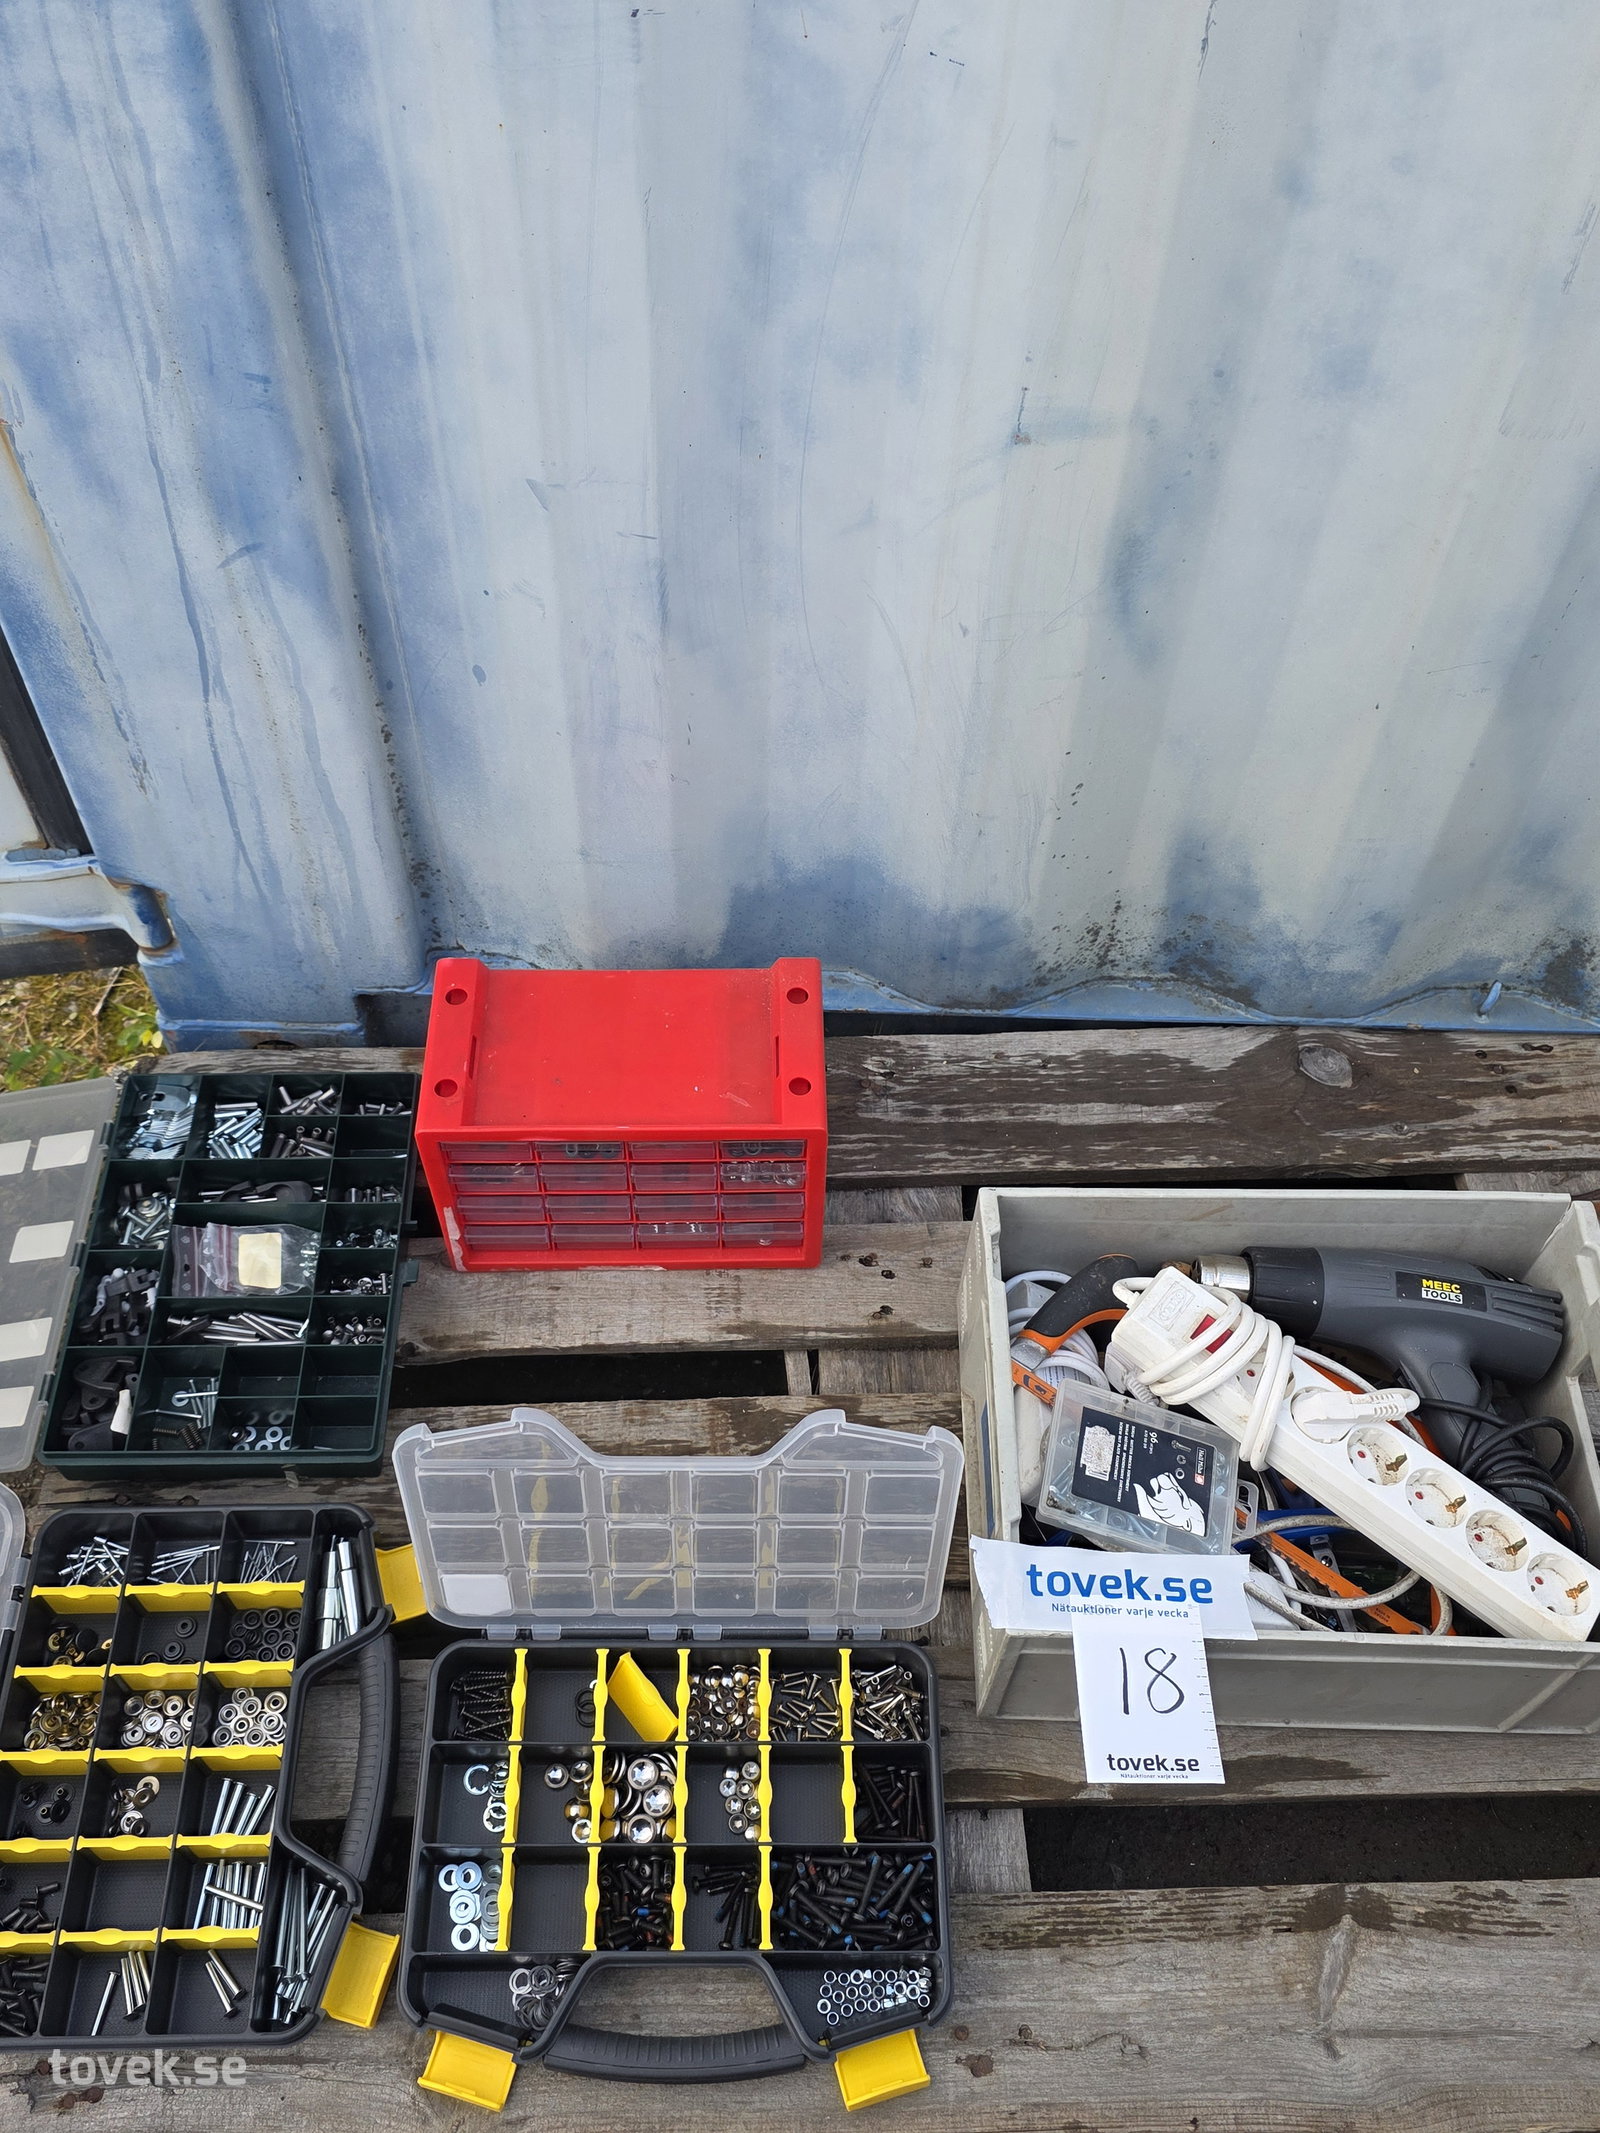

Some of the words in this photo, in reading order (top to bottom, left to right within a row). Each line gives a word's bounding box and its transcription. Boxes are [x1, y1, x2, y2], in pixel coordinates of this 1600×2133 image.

[1422, 1279, 1461, 1293] MEEC
[1423, 1290, 1462, 1302] TOOLS
[1149, 1432, 1159, 1444] 96
[1026, 1563, 1214, 1604] tovek.se
[1051, 1603, 1122, 1616] Nätauktioner
[1126, 1607, 1154, 1619] varje
[1157, 1608, 1189, 1618] vecka
[1119, 1647, 1185, 1715] 18
[1106, 1753, 1200, 1772] tovek.se
